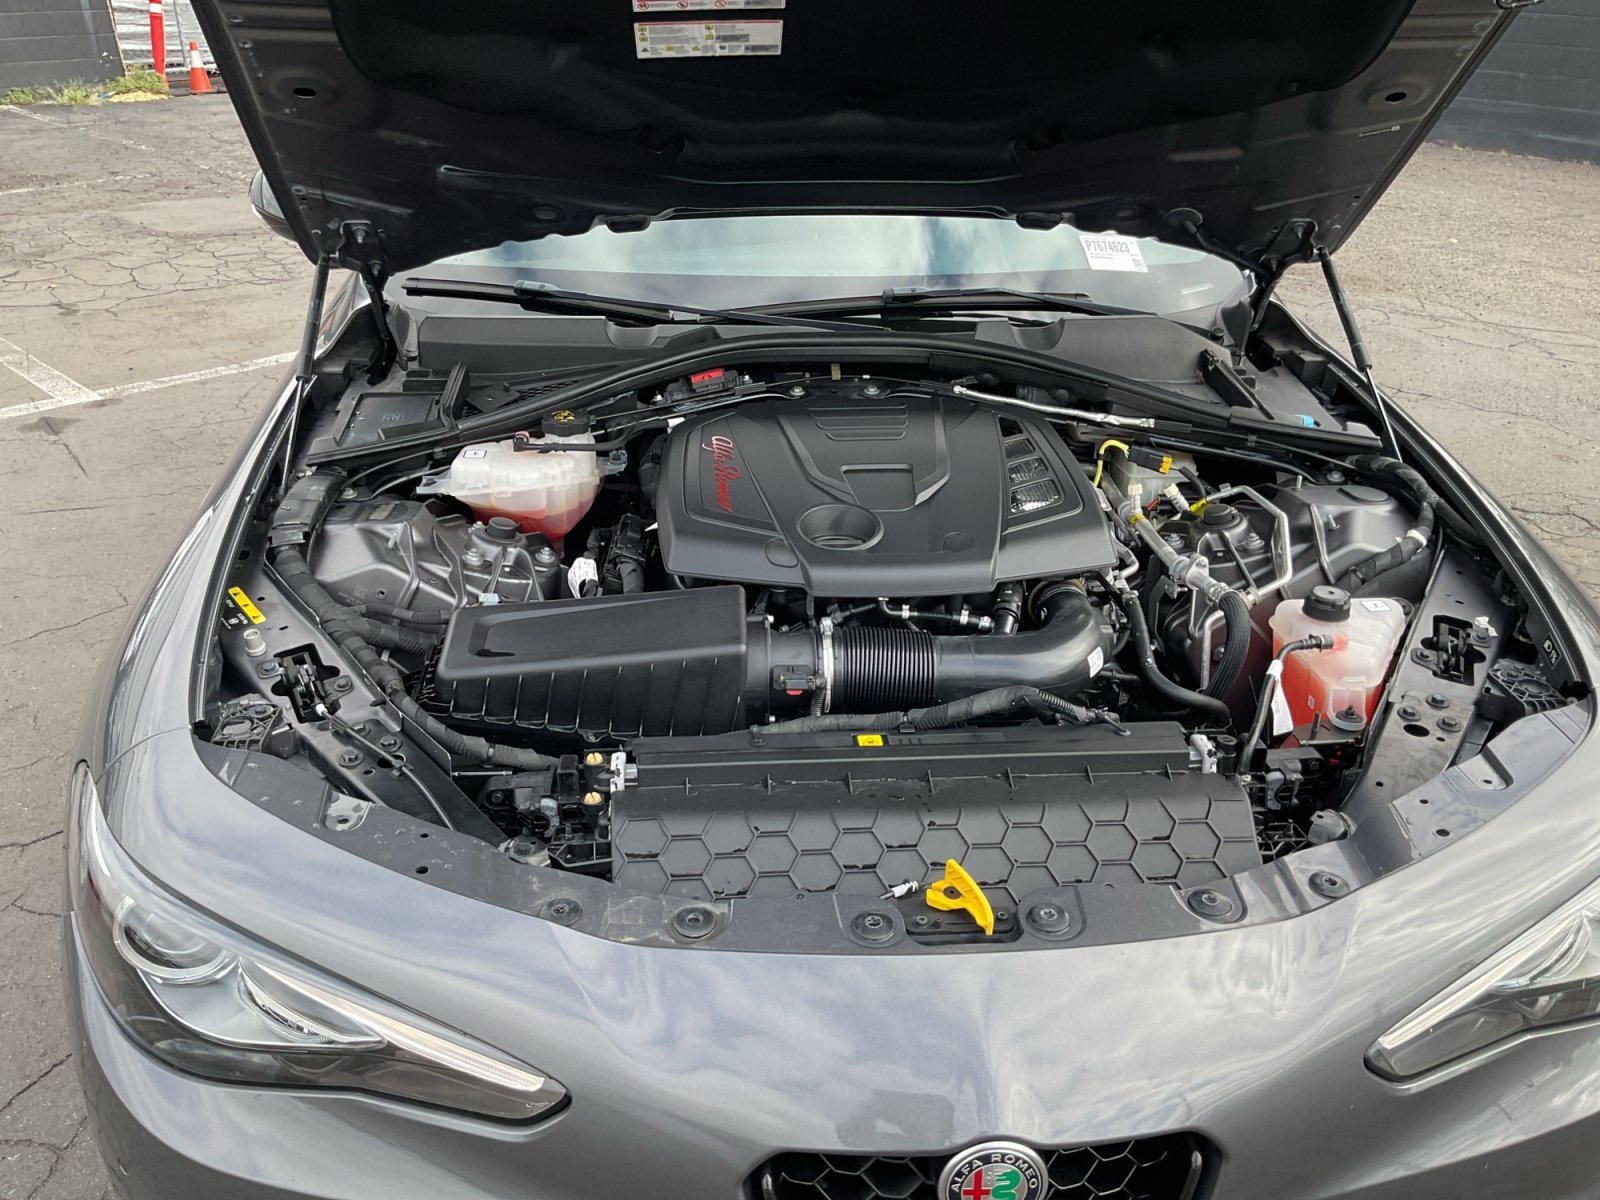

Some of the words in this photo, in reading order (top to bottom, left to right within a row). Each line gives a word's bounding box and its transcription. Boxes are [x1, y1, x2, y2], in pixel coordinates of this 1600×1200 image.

[1085, 240, 1130, 253] P7674623
[951, 1159, 983, 1192] ALFA
[991, 1153, 1038, 1188] ROMEO
